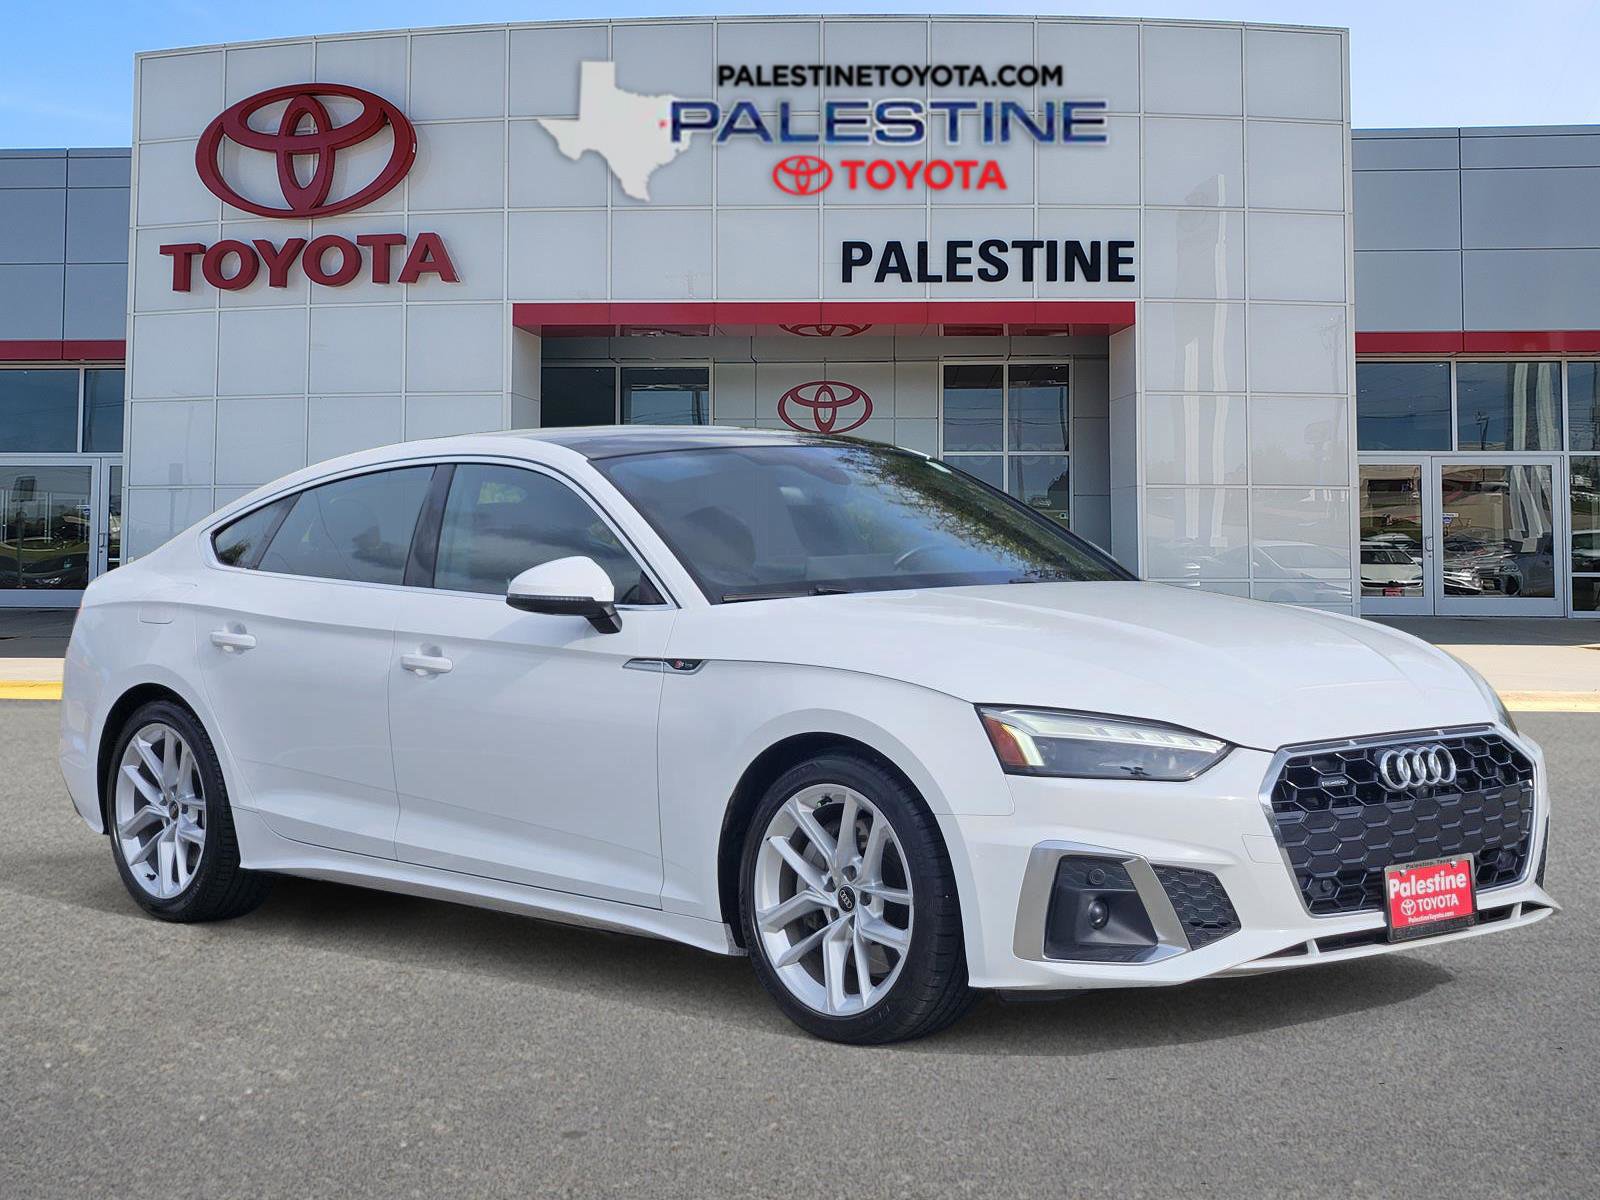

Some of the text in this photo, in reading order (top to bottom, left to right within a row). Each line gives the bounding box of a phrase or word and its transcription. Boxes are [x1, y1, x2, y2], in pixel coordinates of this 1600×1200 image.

[160, 232, 460, 292] TOYOTA
[841, 240, 1135, 283] PALESTINE
[1389, 870, 1466, 899] Palestine
[1417, 894, 1459, 911] TOYOTA
